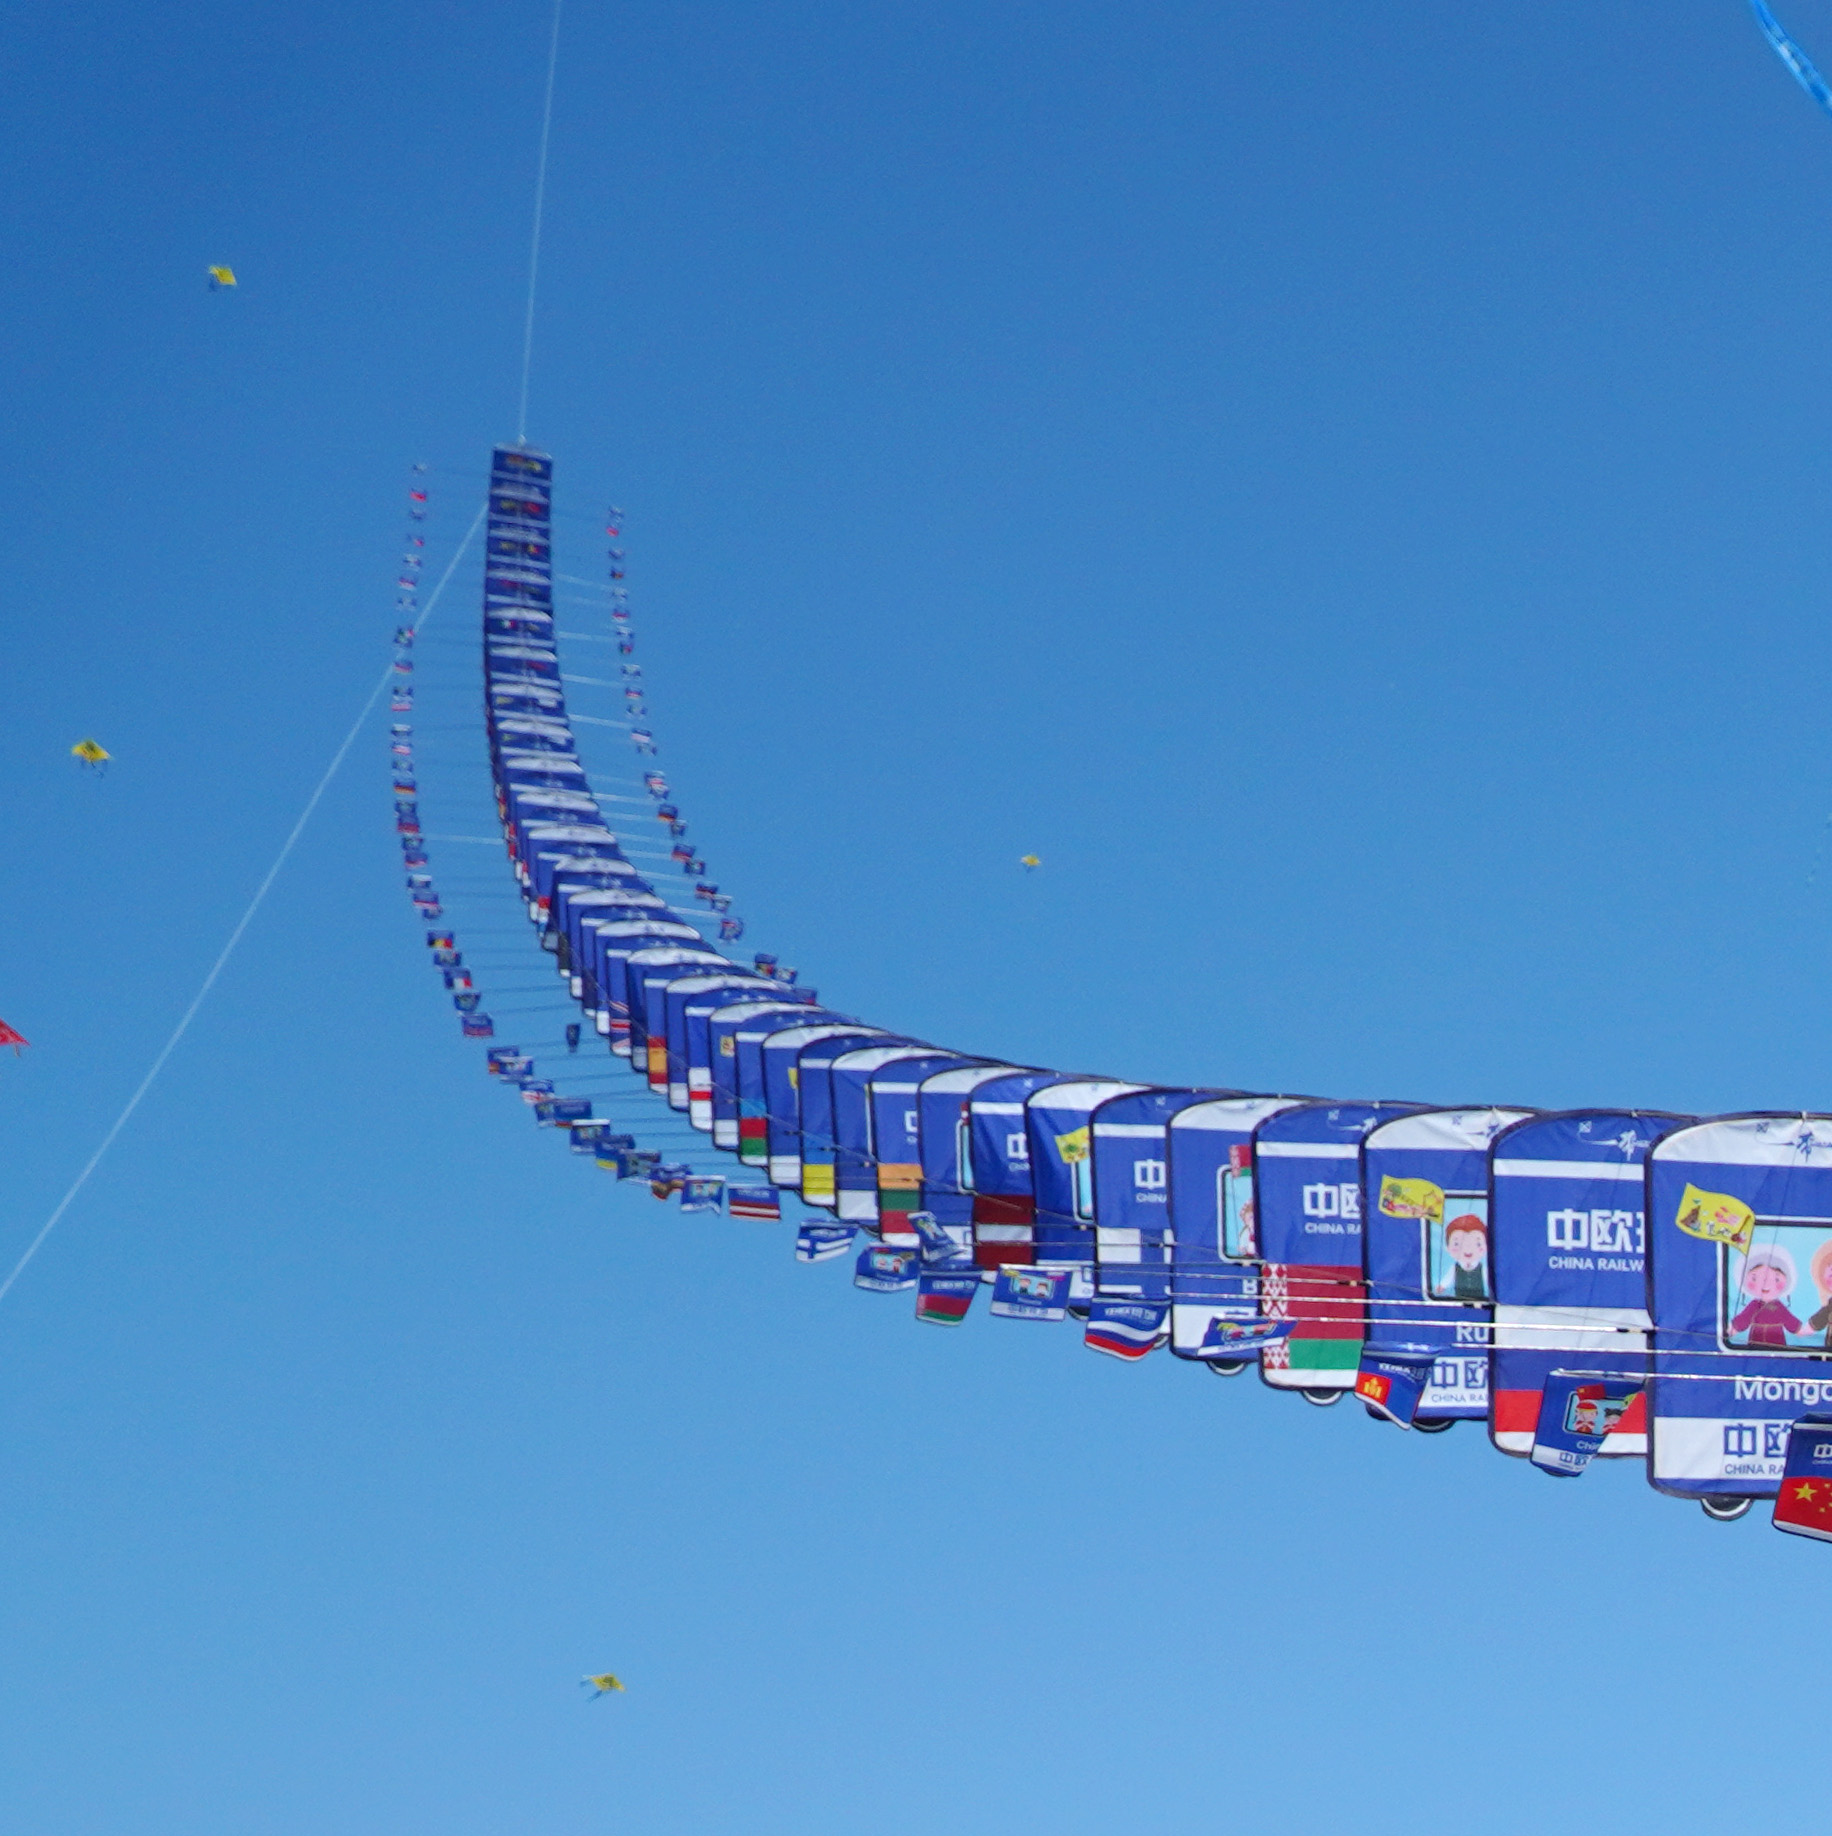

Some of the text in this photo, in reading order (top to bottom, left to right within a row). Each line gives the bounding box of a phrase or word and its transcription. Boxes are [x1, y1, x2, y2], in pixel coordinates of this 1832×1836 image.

[1549, 1255, 1644, 1272] CHINA RAILW
[1724, 1464, 1765, 1474] CHINA
